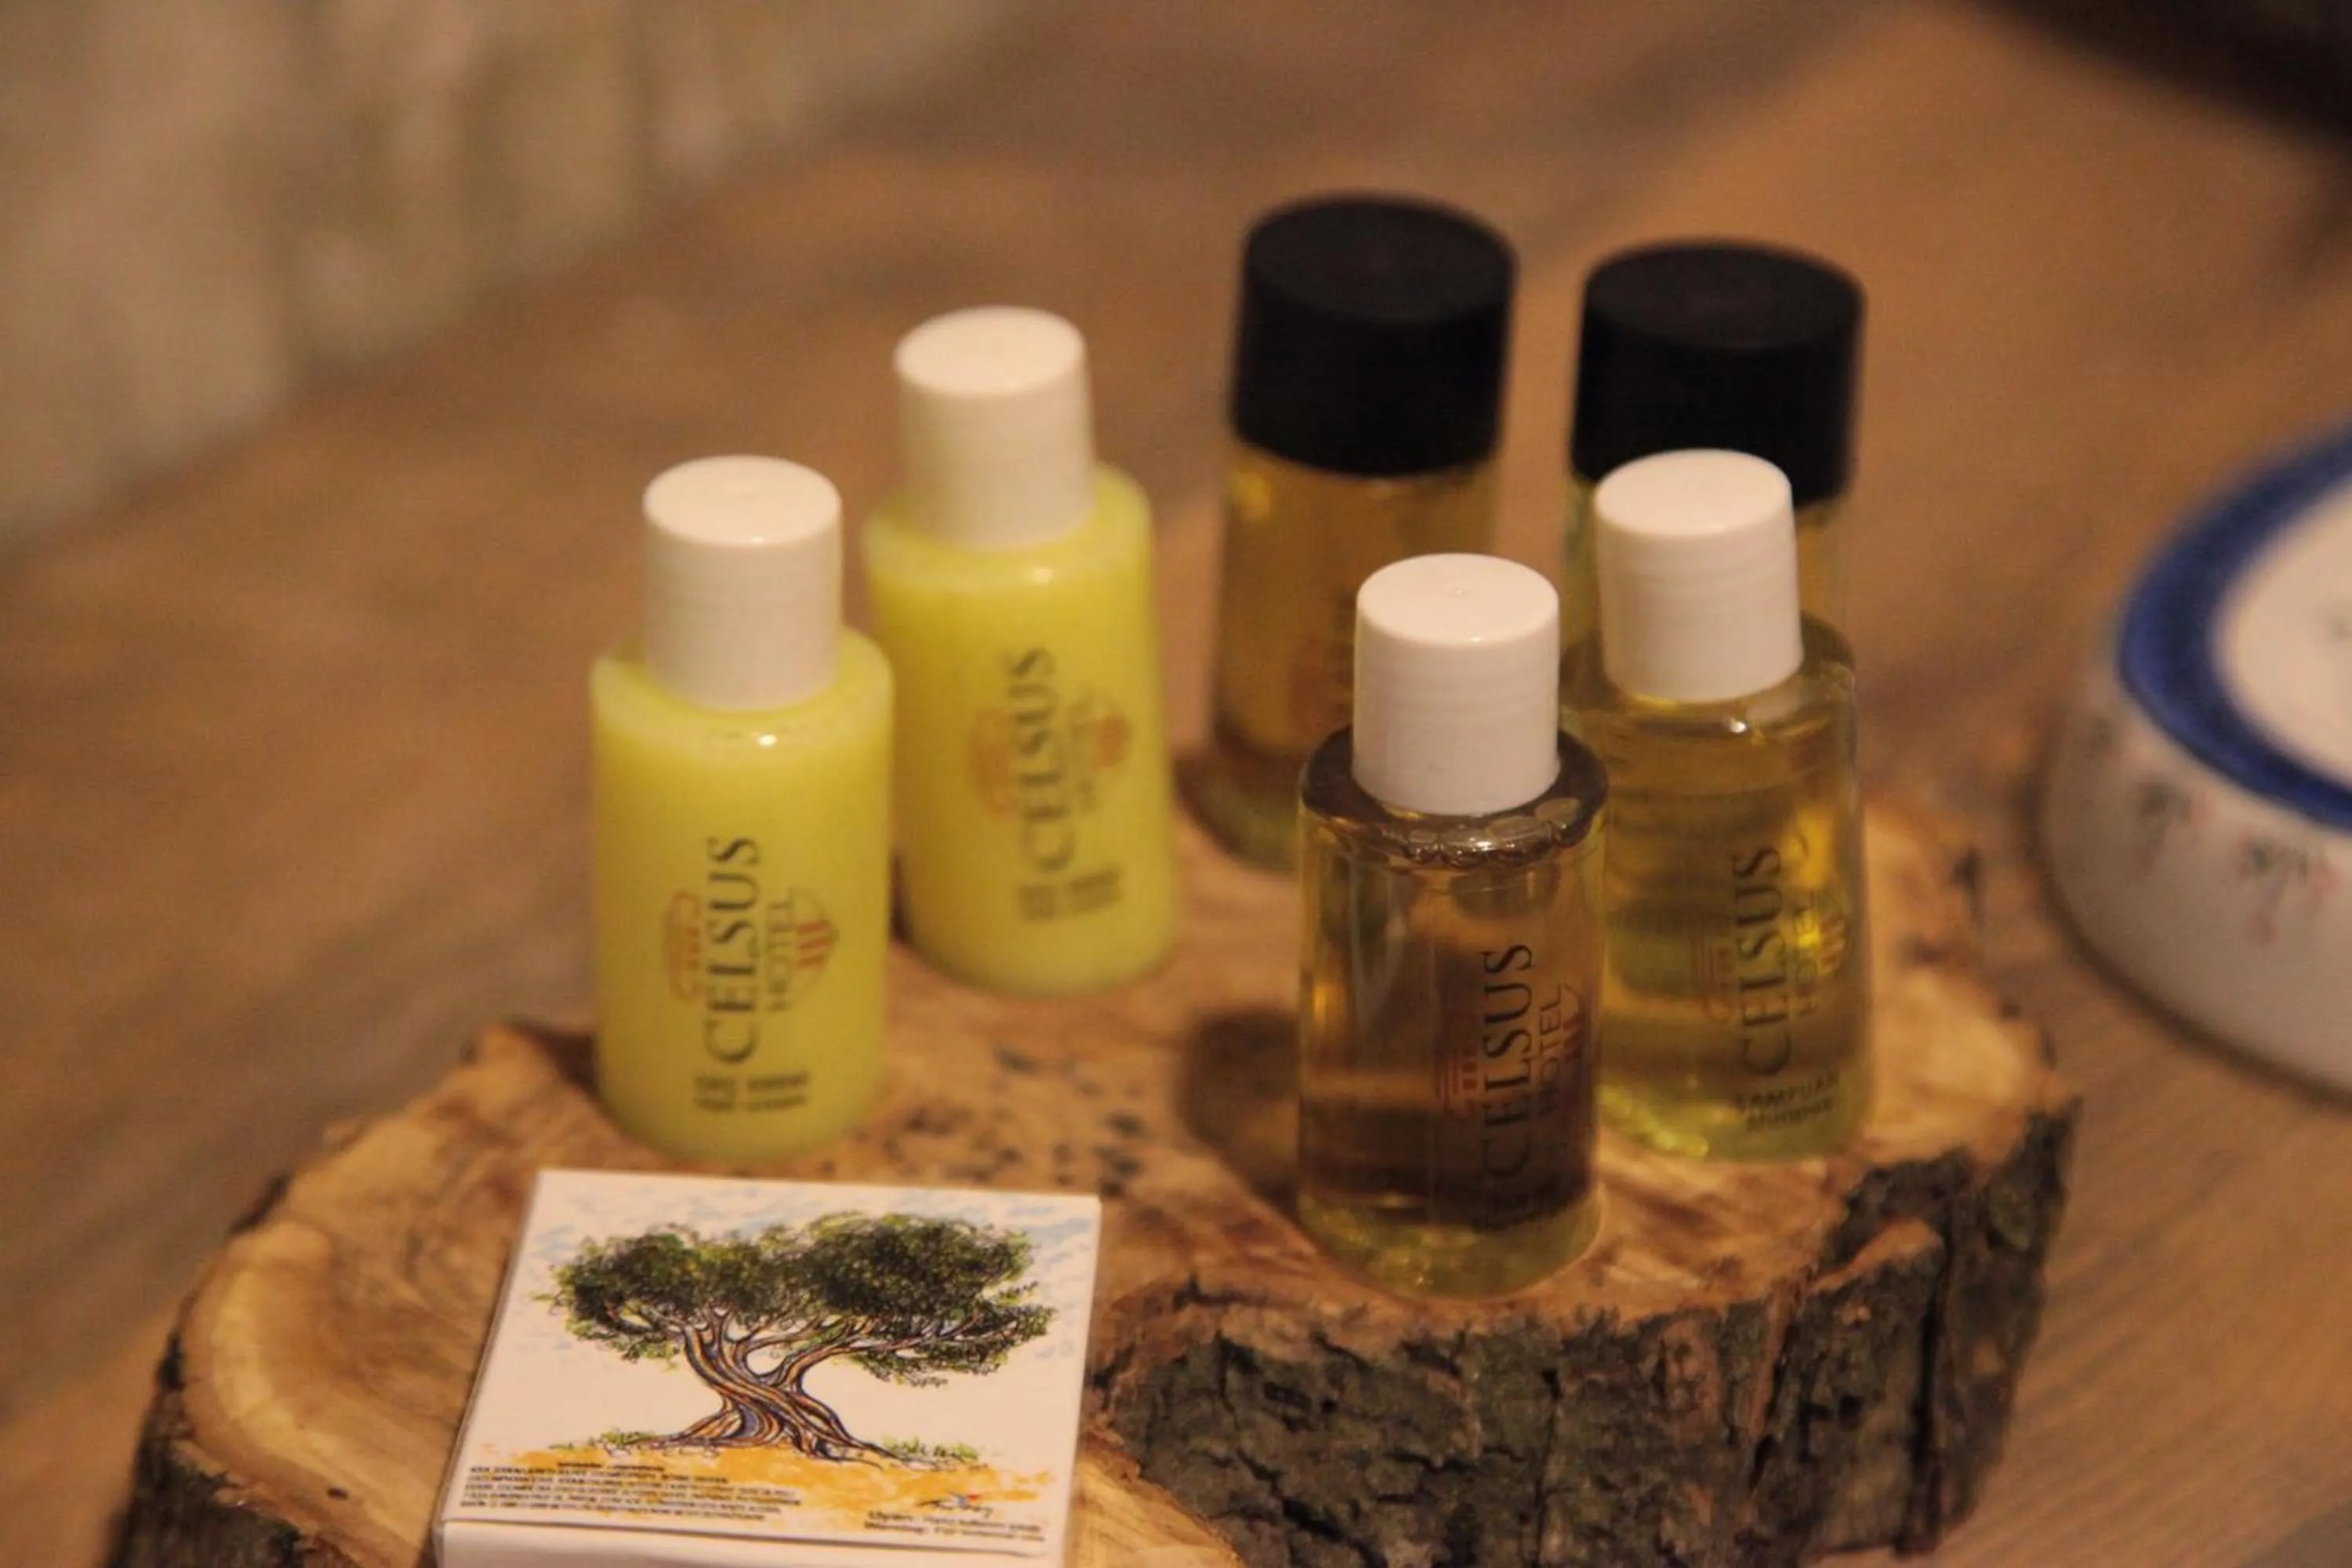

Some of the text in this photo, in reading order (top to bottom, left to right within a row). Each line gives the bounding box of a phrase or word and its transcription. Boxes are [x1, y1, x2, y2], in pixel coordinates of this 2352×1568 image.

[1001, 647, 1075, 873] CELSUS
[704, 836, 760, 1065] CELSUS
[1483, 943, 1533, 1176] CELSUS
[1733, 847, 1791, 1076] CELSUS
